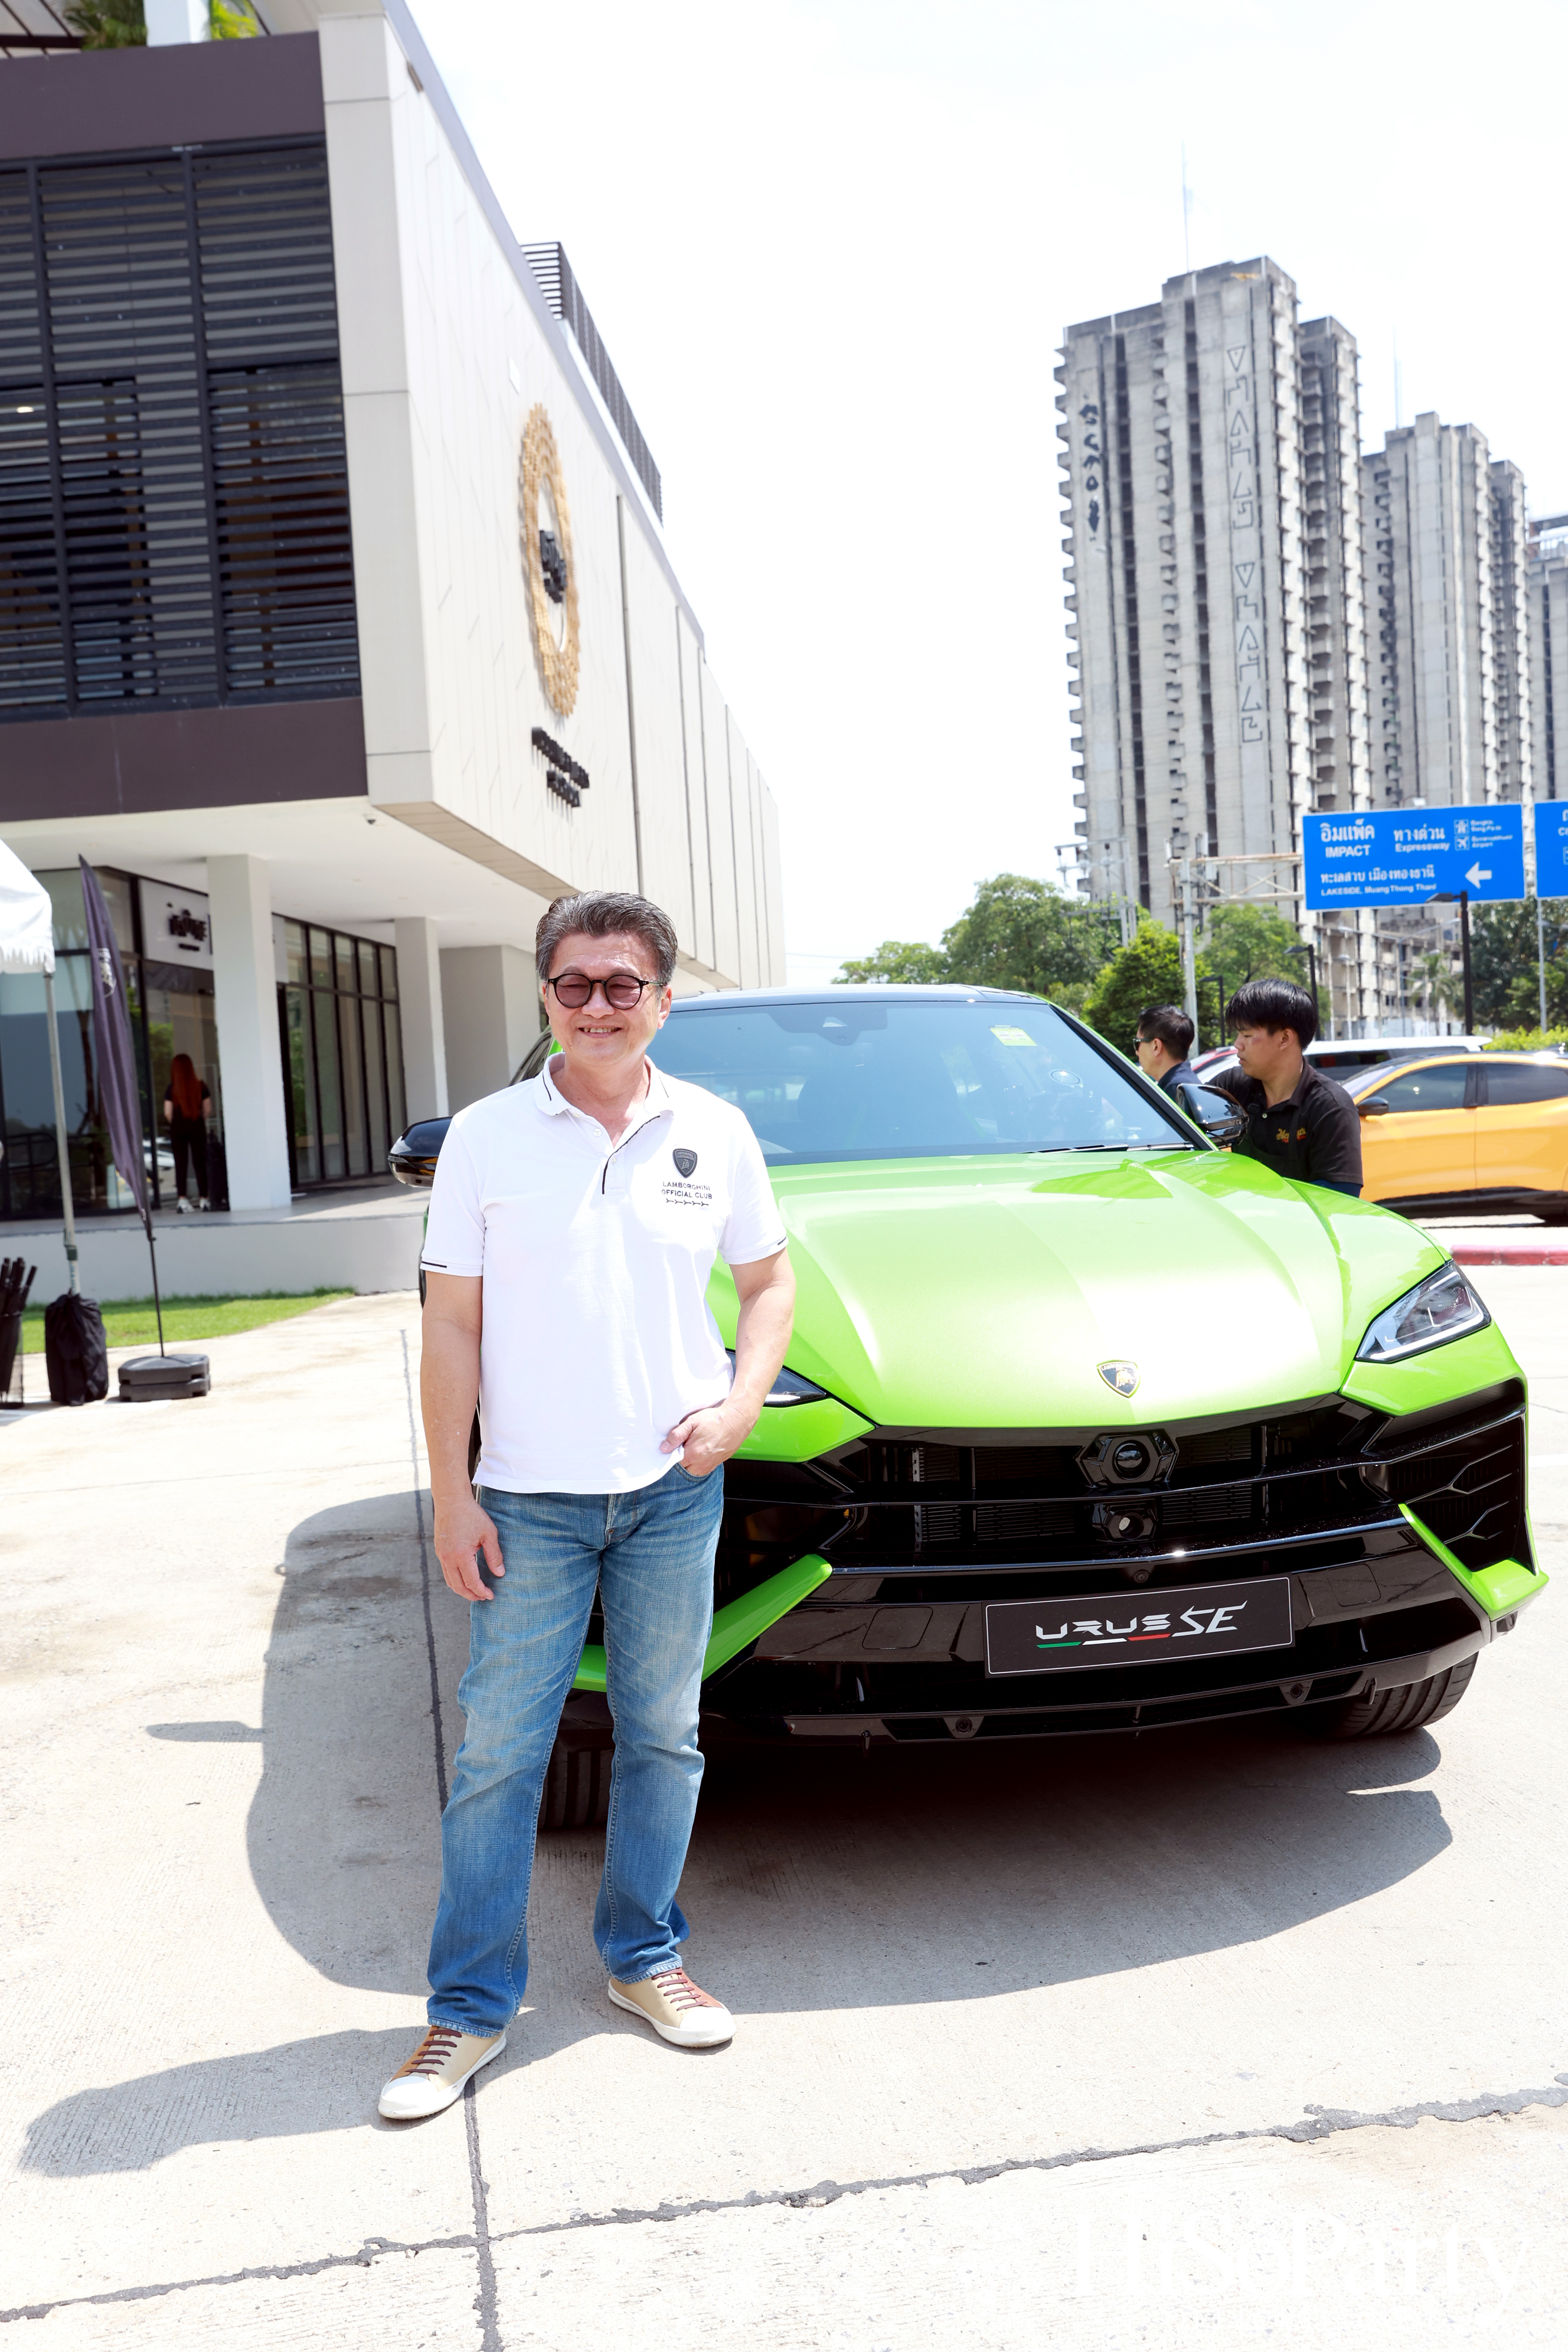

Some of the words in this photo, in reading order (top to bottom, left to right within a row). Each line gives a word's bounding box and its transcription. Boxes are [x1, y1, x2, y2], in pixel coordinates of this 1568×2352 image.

[1319, 818, 1375, 842] อิมแพ็ค
[1393, 823, 1445, 842] ทางด่วน
[1325, 844, 1371, 858] IMPACT
[1395, 842, 1451, 854] Expressway
[1320, 870, 1366, 884] ทะเลสาบ
[1368, 864, 1435, 881] เมืองทองธานี
[1364, 884, 1390, 894] Muang
[662, 1181, 710, 1191] LAMBORGHINI
[661, 1189, 692, 1198] OFFICIAL
[1035, 1613, 1171, 1640] URUS
[1171, 1600, 1248, 1637] SE
